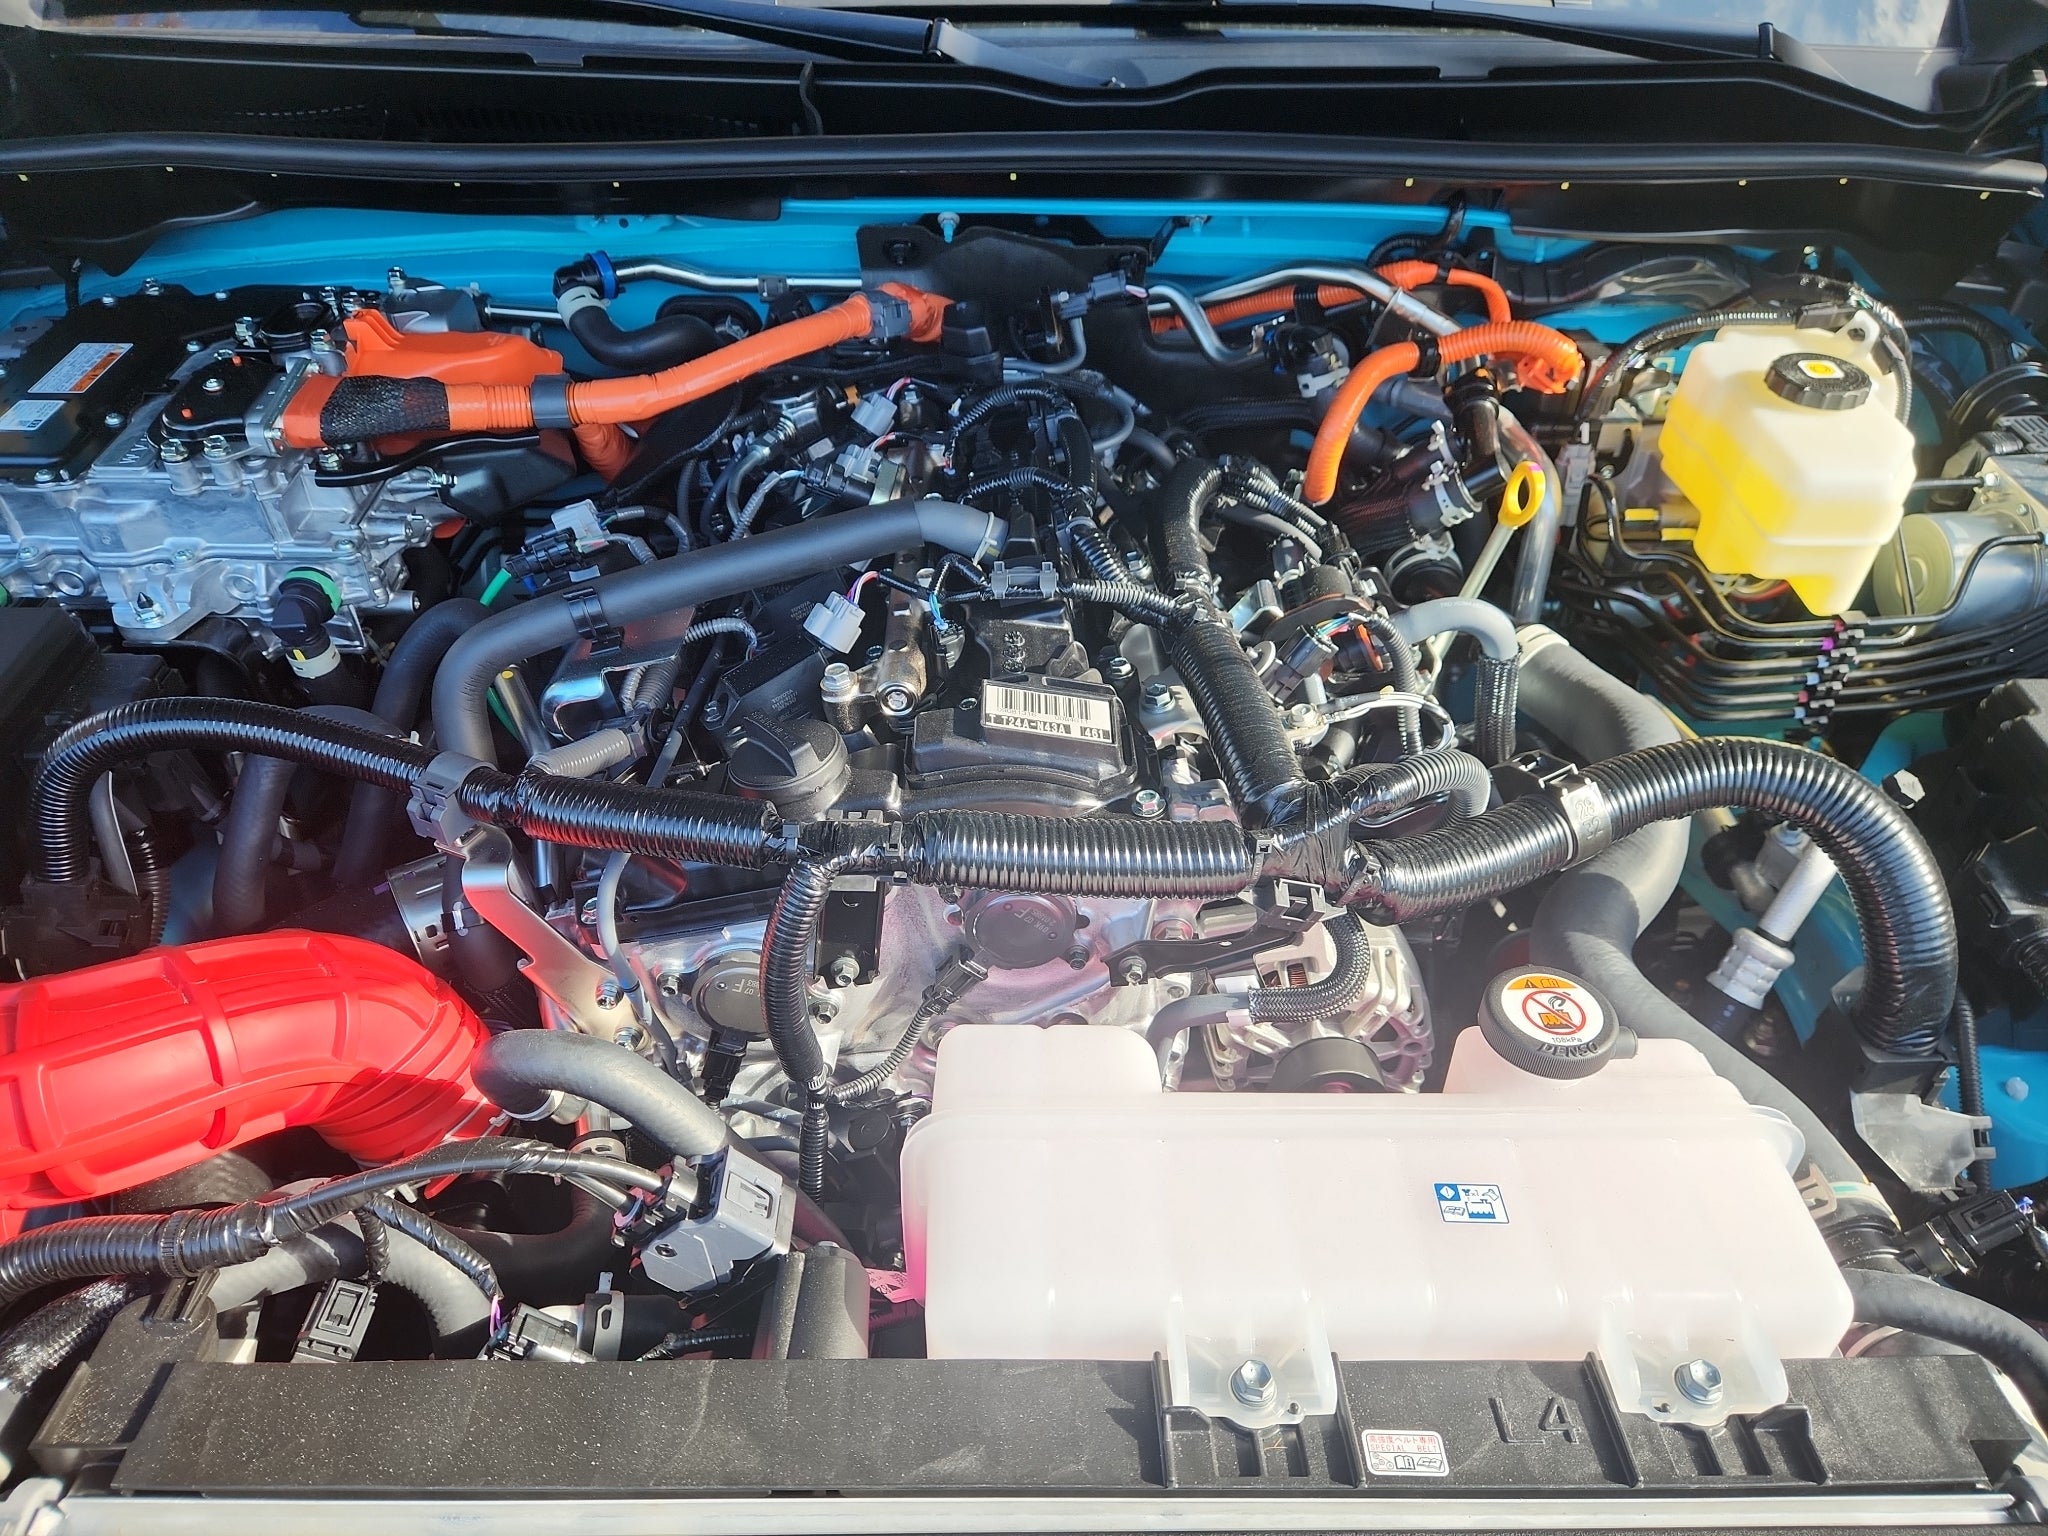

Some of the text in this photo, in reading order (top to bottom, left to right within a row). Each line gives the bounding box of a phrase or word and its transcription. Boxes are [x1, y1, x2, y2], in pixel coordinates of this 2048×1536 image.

[1001, 715, 1066, 734] T24A-N43A
[1551, 1036, 1583, 1044] 108kPa
[1537, 1041, 1599, 1058] DENSO
[1370, 1444, 1438, 1453] SPECIAL BELT
